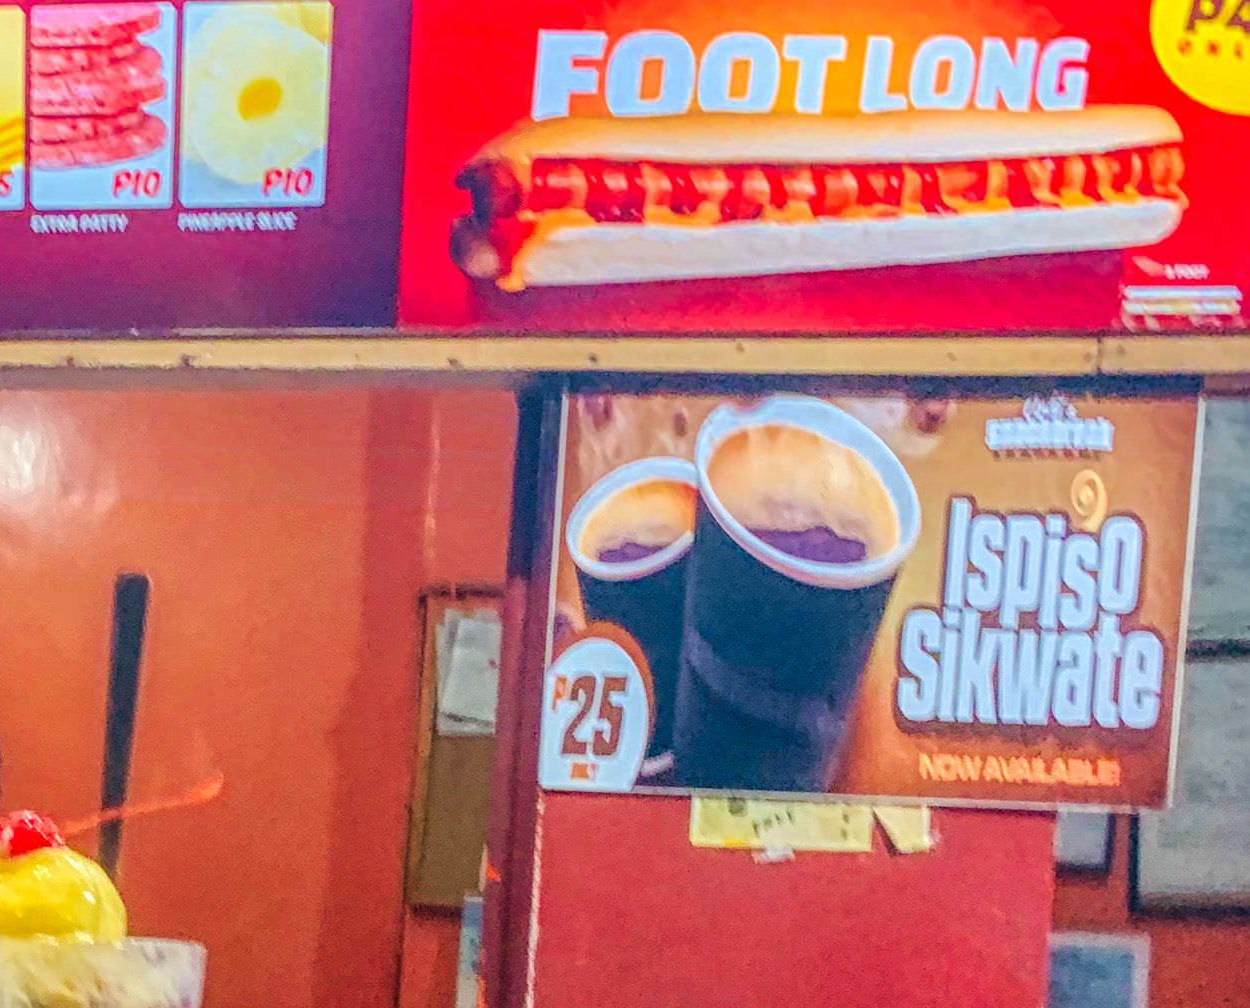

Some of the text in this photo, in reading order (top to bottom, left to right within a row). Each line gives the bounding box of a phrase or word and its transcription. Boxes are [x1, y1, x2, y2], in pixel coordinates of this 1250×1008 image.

[532, 28, 1091, 121] FOOT LONG
[112, 169, 162, 198] P10
[261, 167, 314, 198] P10
[944, 497, 1143, 632] Ispiso
[897, 602, 1164, 730] Sikwate
[918, 752, 981, 782] NOW
